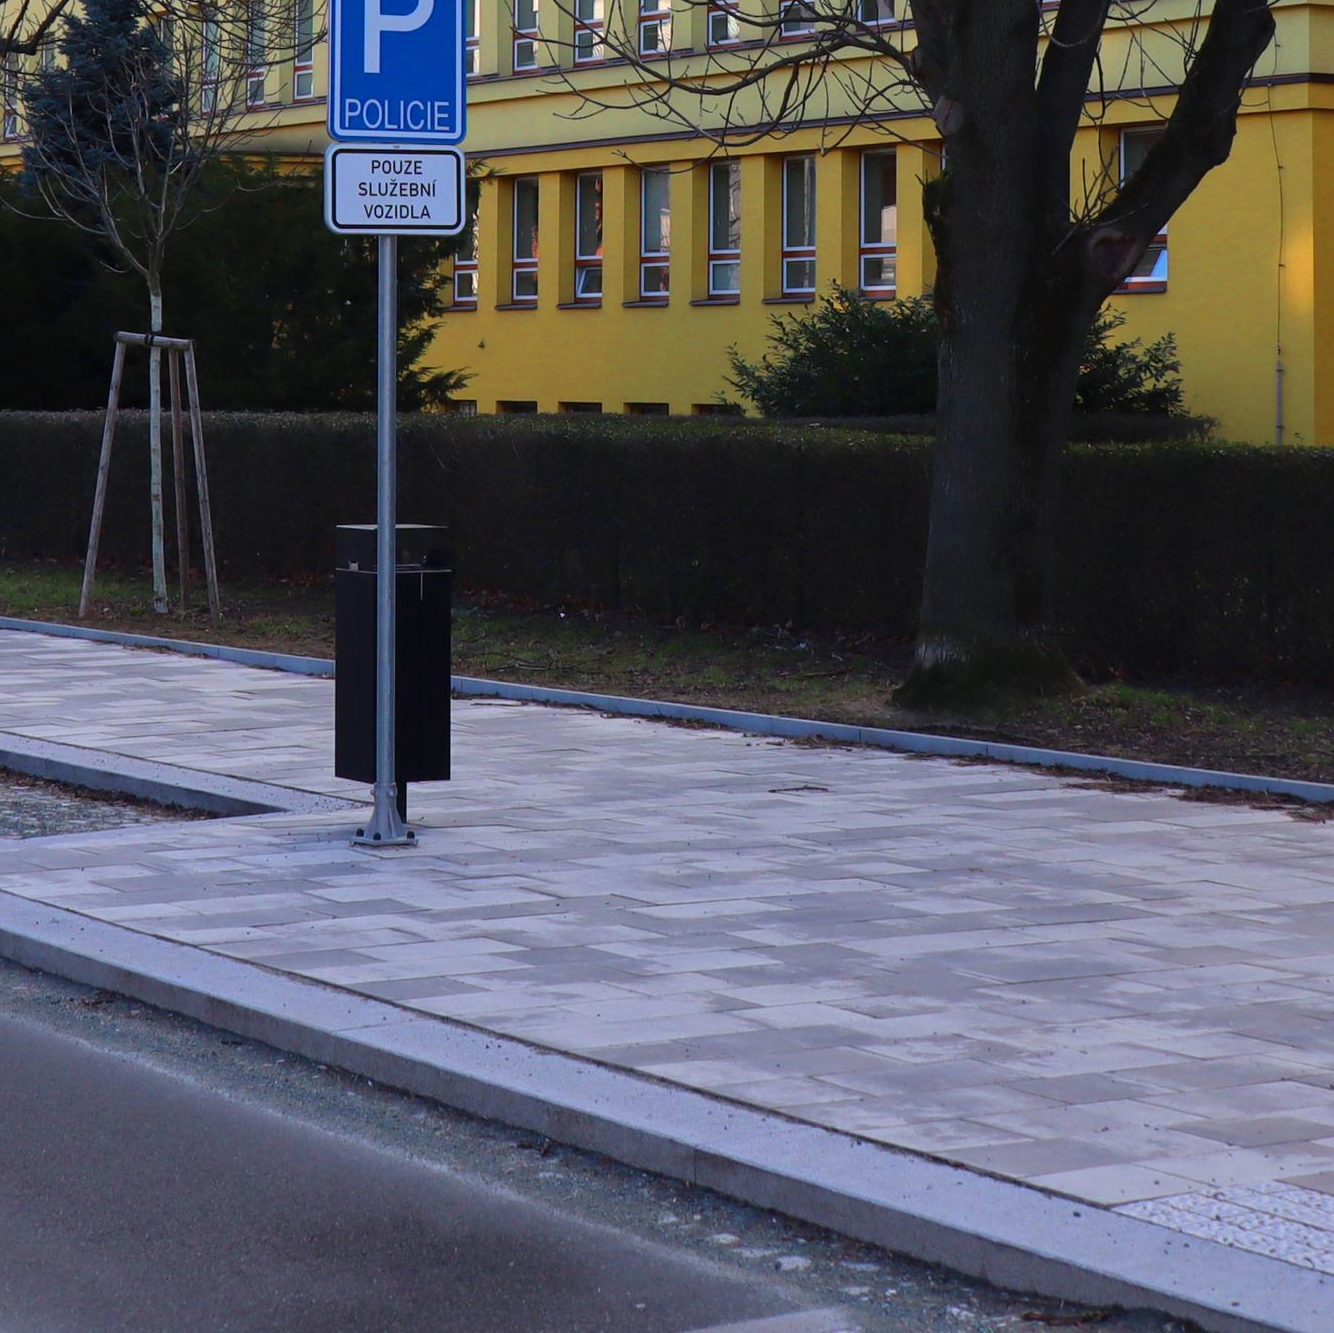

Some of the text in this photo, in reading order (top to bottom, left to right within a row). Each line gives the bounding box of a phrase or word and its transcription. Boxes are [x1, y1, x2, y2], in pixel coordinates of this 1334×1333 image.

[344, 98, 451, 131] POLICIE
[371, 159, 424, 176] POUZE
[357, 178, 437, 198] SLUŽEBNÍ
[363, 203, 432, 220] VOZIDLA
